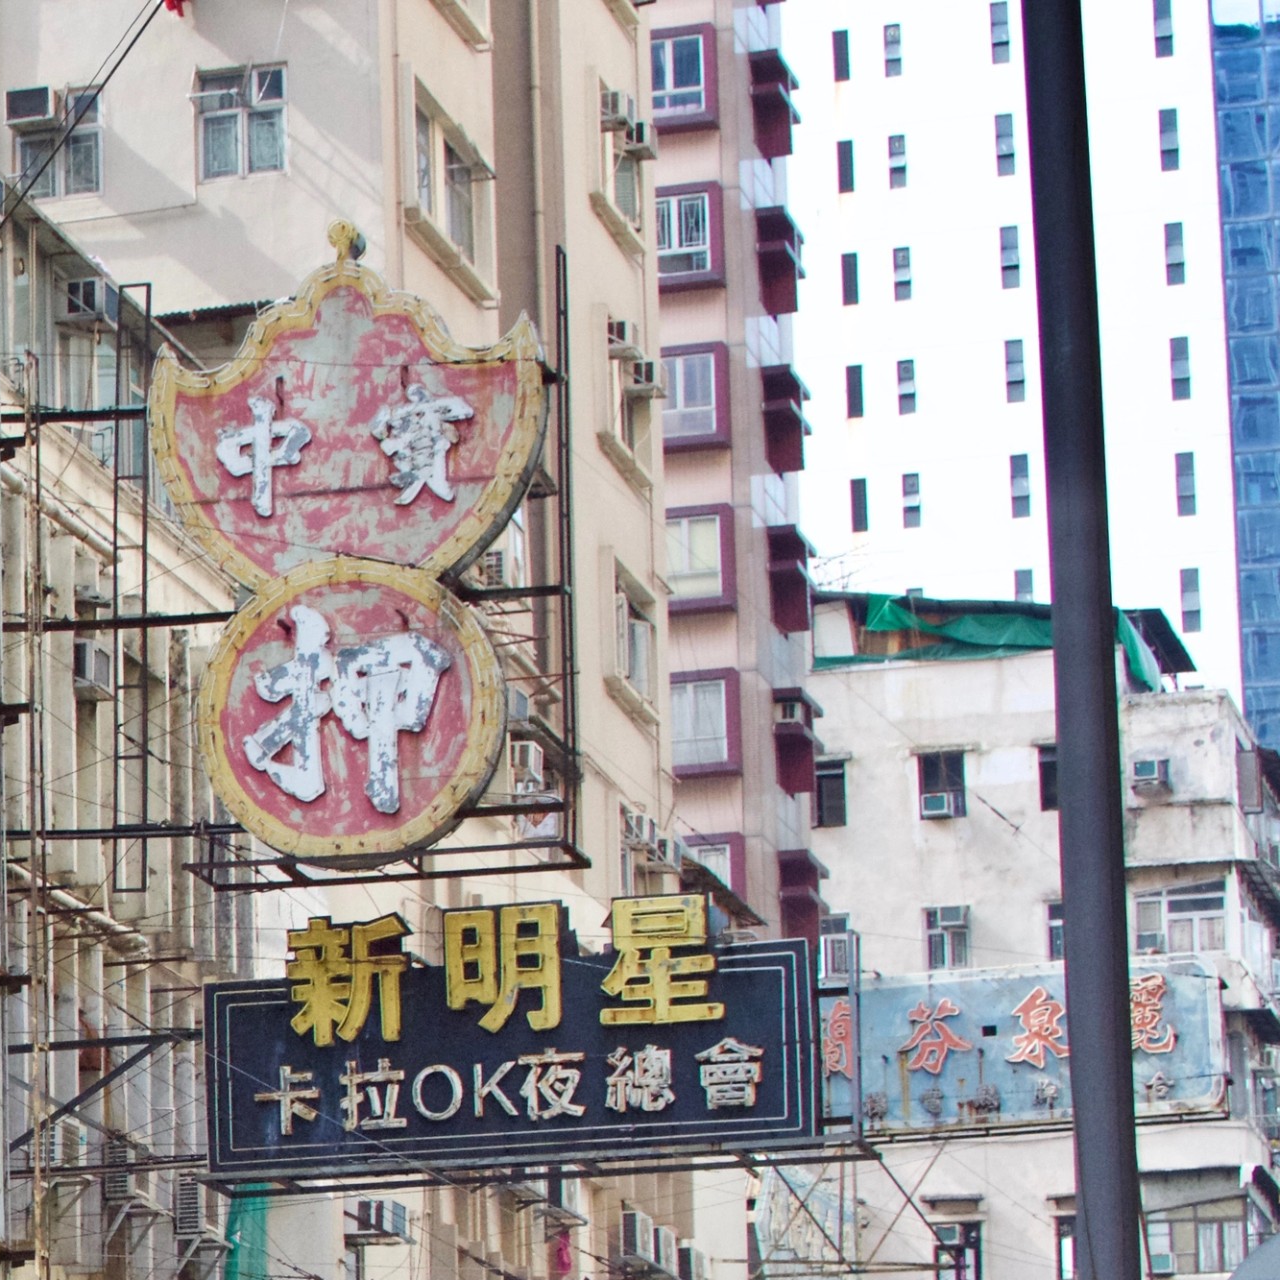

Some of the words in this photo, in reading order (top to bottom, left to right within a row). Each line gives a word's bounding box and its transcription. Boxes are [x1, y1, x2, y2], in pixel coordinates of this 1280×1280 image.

[243, 603, 451, 814] 押
[288, 893, 725, 1048] 新明星
[255, 1037, 764, 1135] 卡拉OK夜總會
